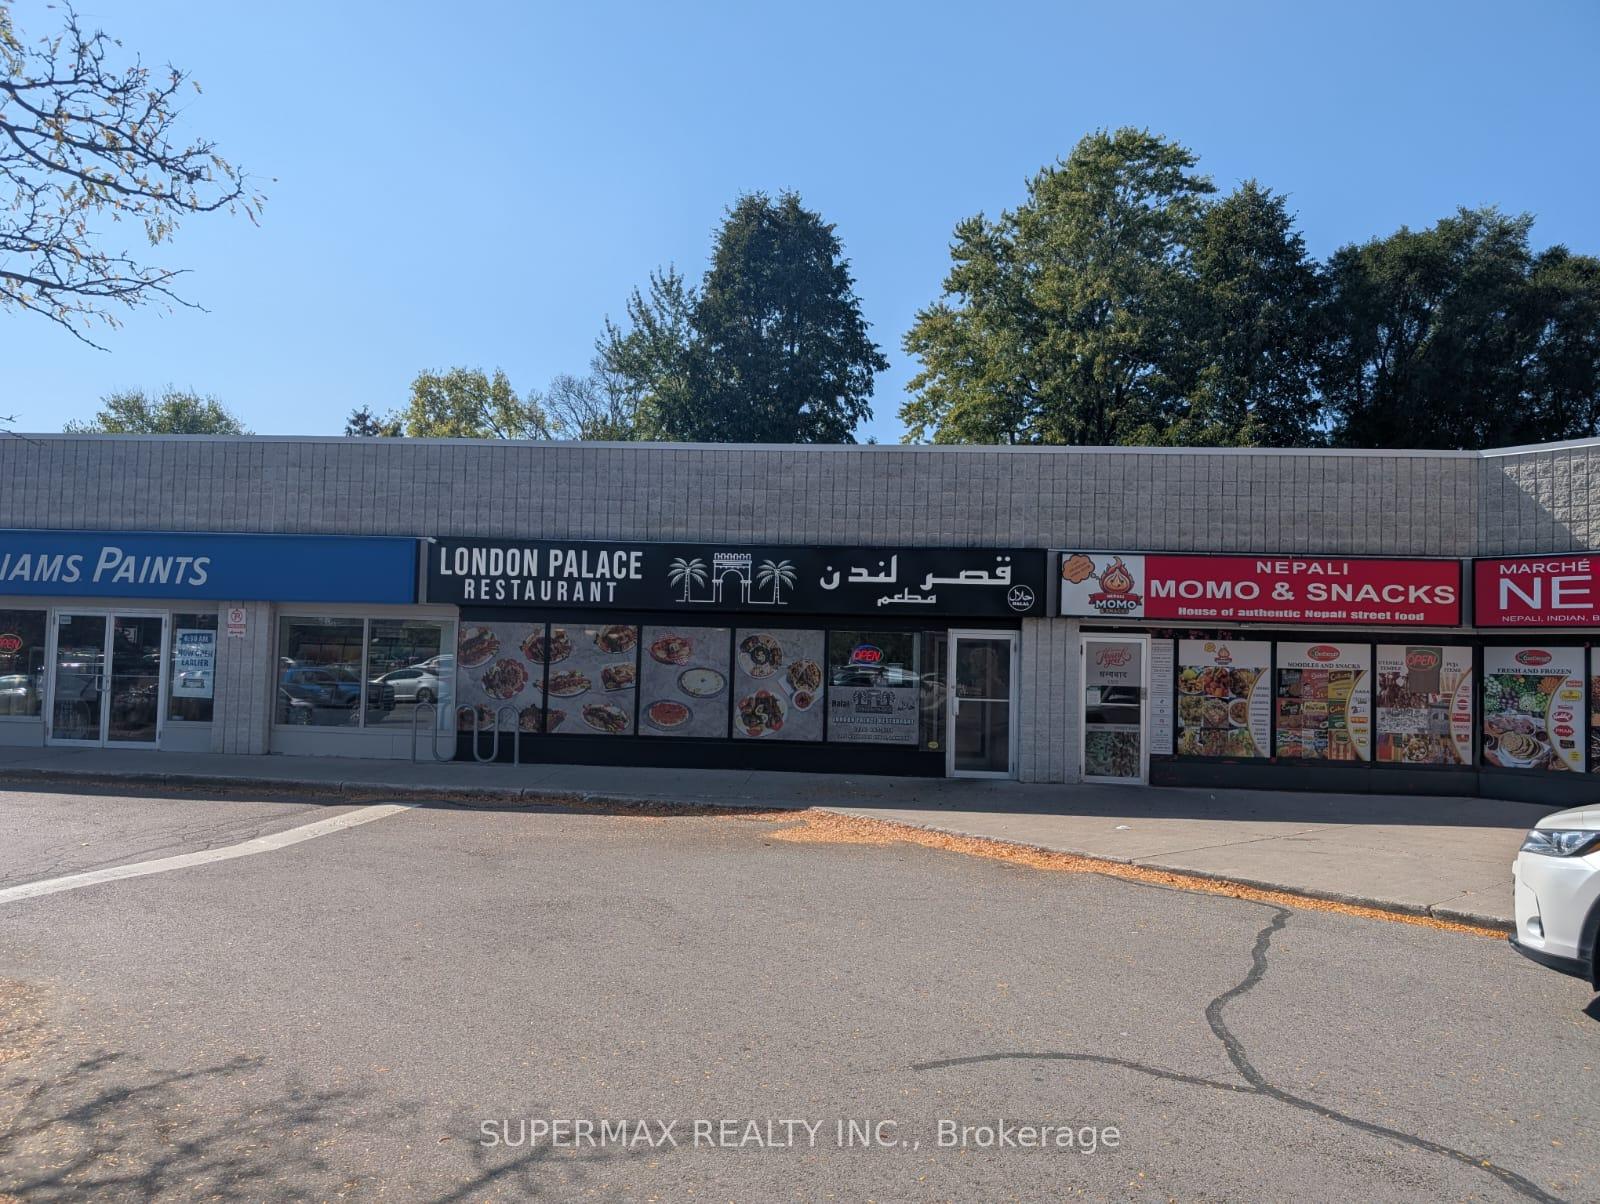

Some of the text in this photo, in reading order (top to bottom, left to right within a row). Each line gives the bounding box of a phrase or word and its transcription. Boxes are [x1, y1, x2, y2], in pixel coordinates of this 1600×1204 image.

[0, 546, 211, 586] IAMS PAINTS
[440, 547, 644, 579] LONDON PALACE
[1256, 561, 1349, 576] NEPALI
[1499, 558, 1590, 575] MARCHÉ
[819, 554, 1011, 590] قصر لندن
[464, 578, 618, 603] RESTAURANT
[877, 587, 936, 607] مطعم
[1150, 579, 1456, 605] MOMO & SNACKS
[1499, 575, 1594, 610] NE
[1095, 600, 1137, 610] MOMO
[1178, 606, 1425, 621] House of authentic Nepali street food
[1502, 615, 1544, 623] NEPALI,
[181, 659, 209, 668] EARLIER
[854, 648, 881, 662] OPEN
[1407, 653, 1438, 666] OPEN
